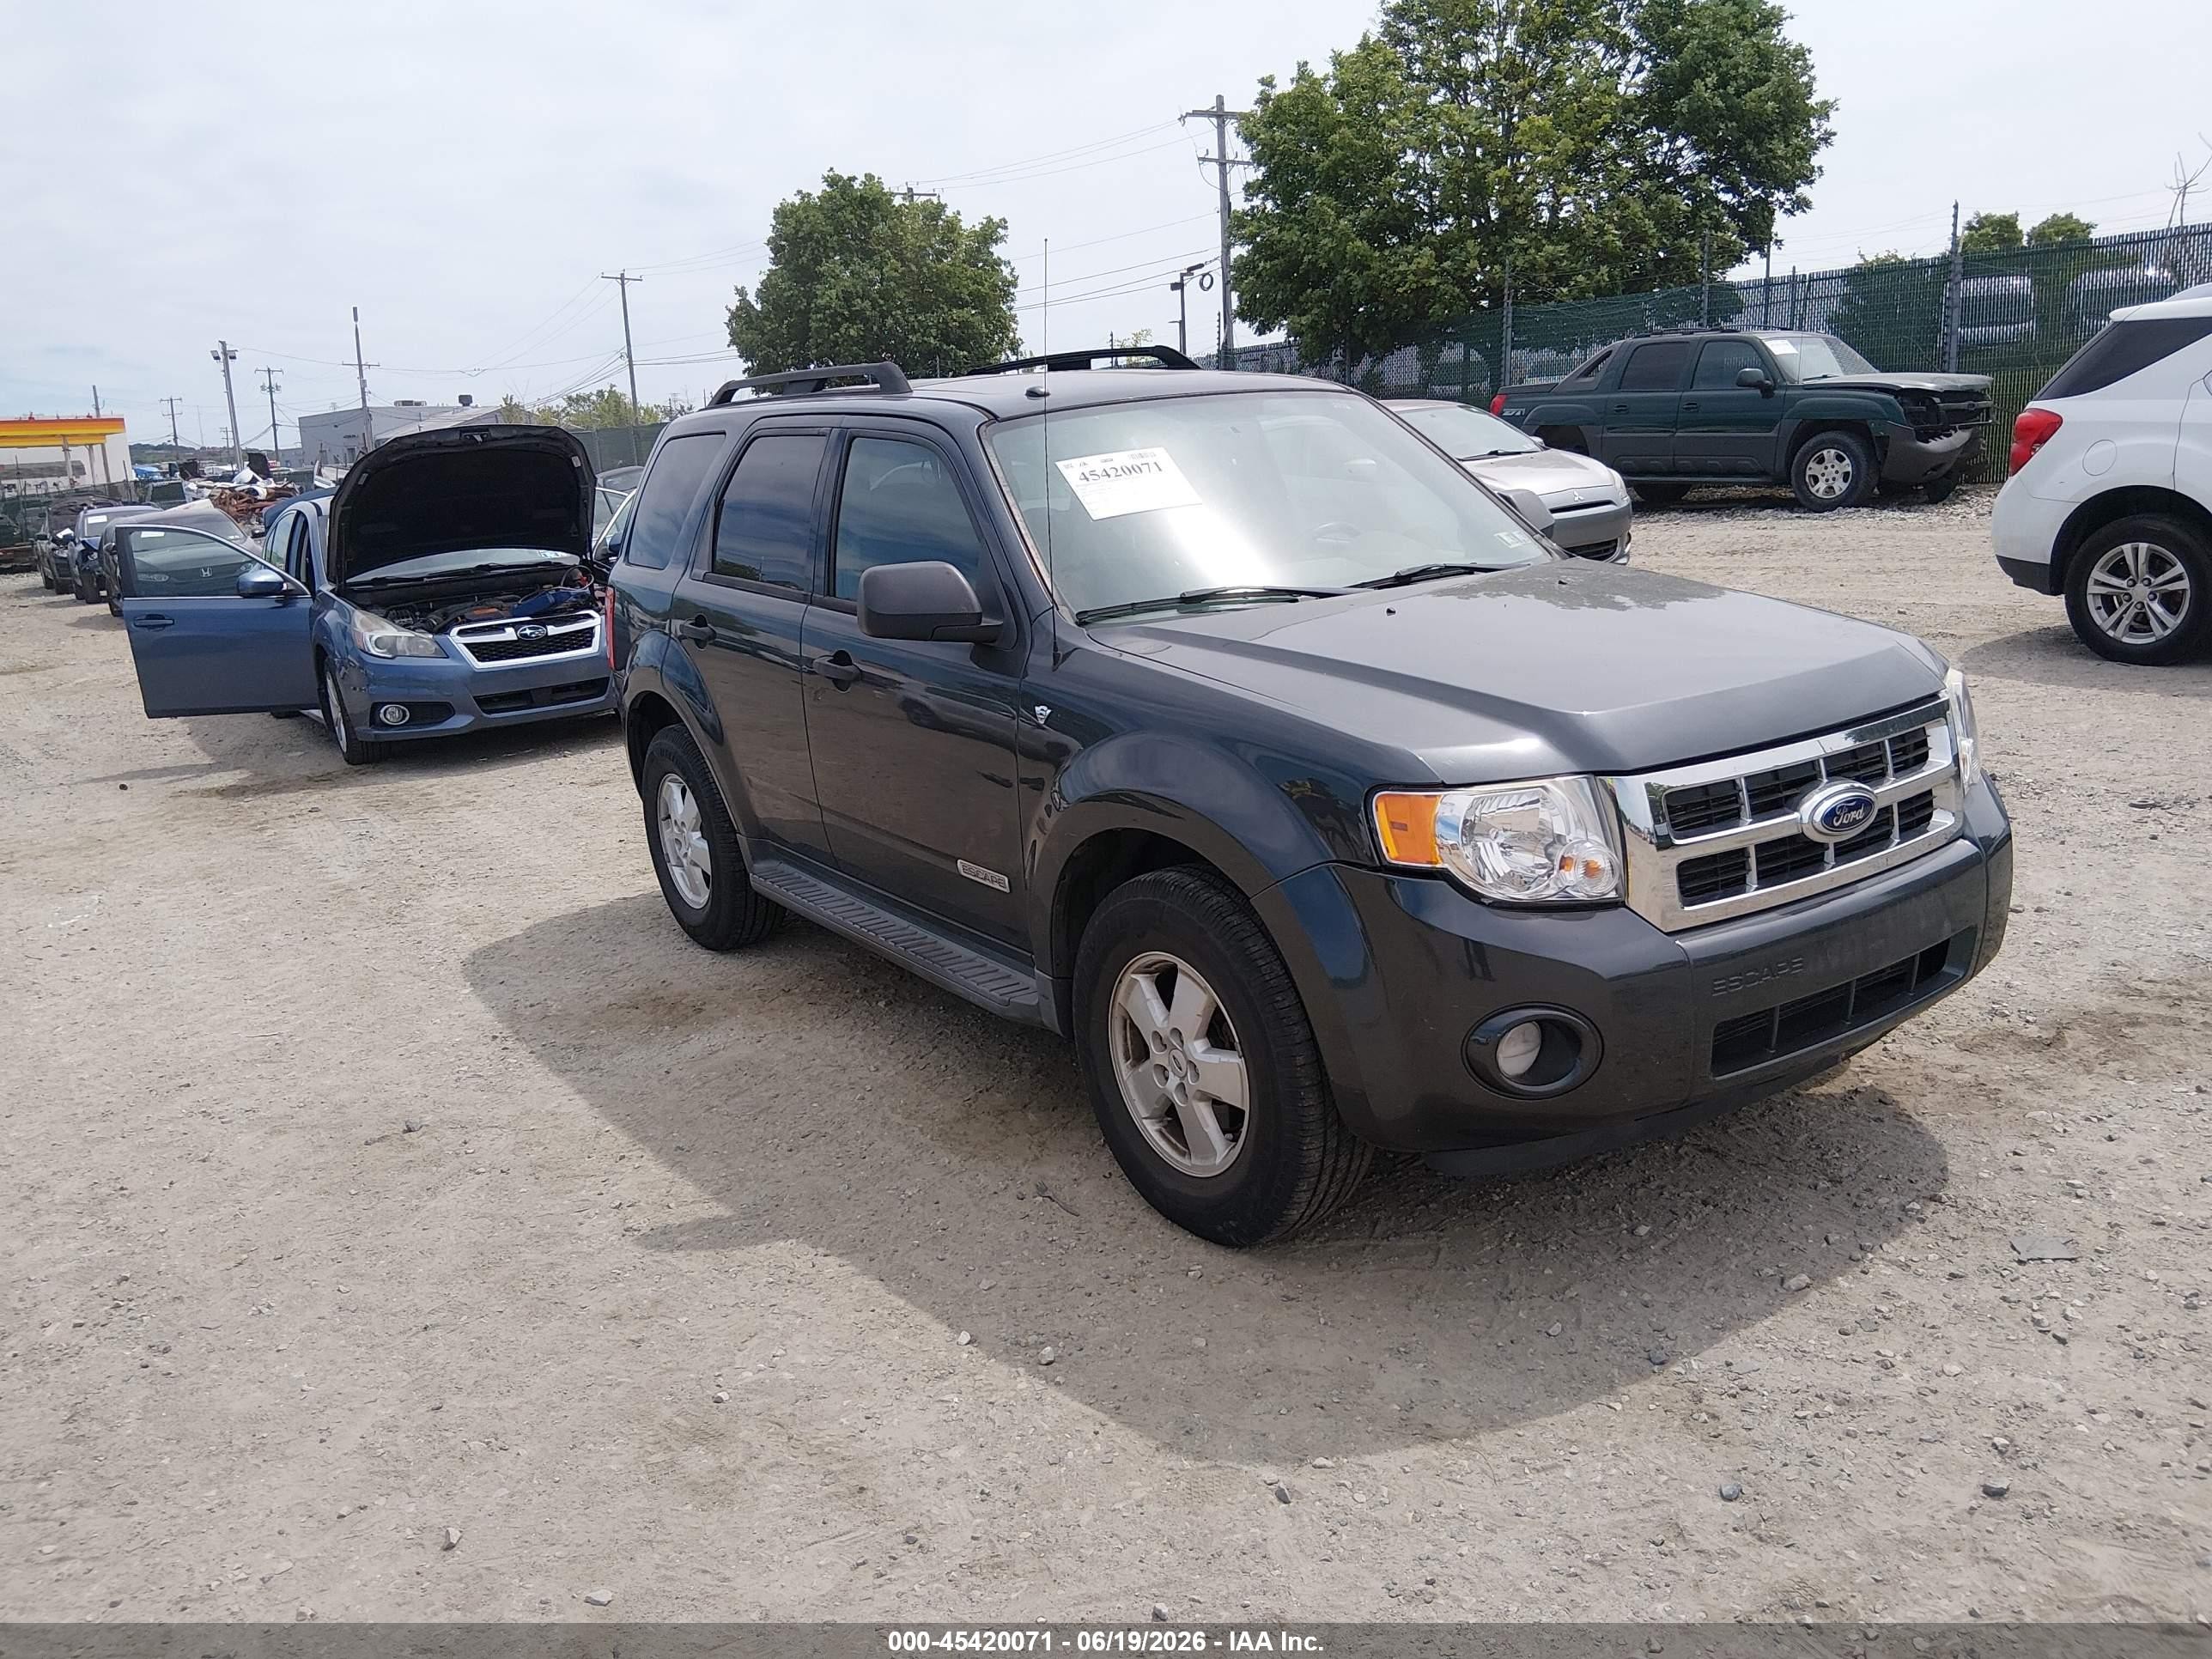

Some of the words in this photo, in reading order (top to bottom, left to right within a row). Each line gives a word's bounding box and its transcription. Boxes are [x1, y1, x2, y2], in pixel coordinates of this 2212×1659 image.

[1079, 461, 1163, 482] 45420071
[1833, 800, 1865, 828] Ford
[962, 864, 1007, 889] ESCAPE
[1711, 957, 1805, 996] ESCAPE
